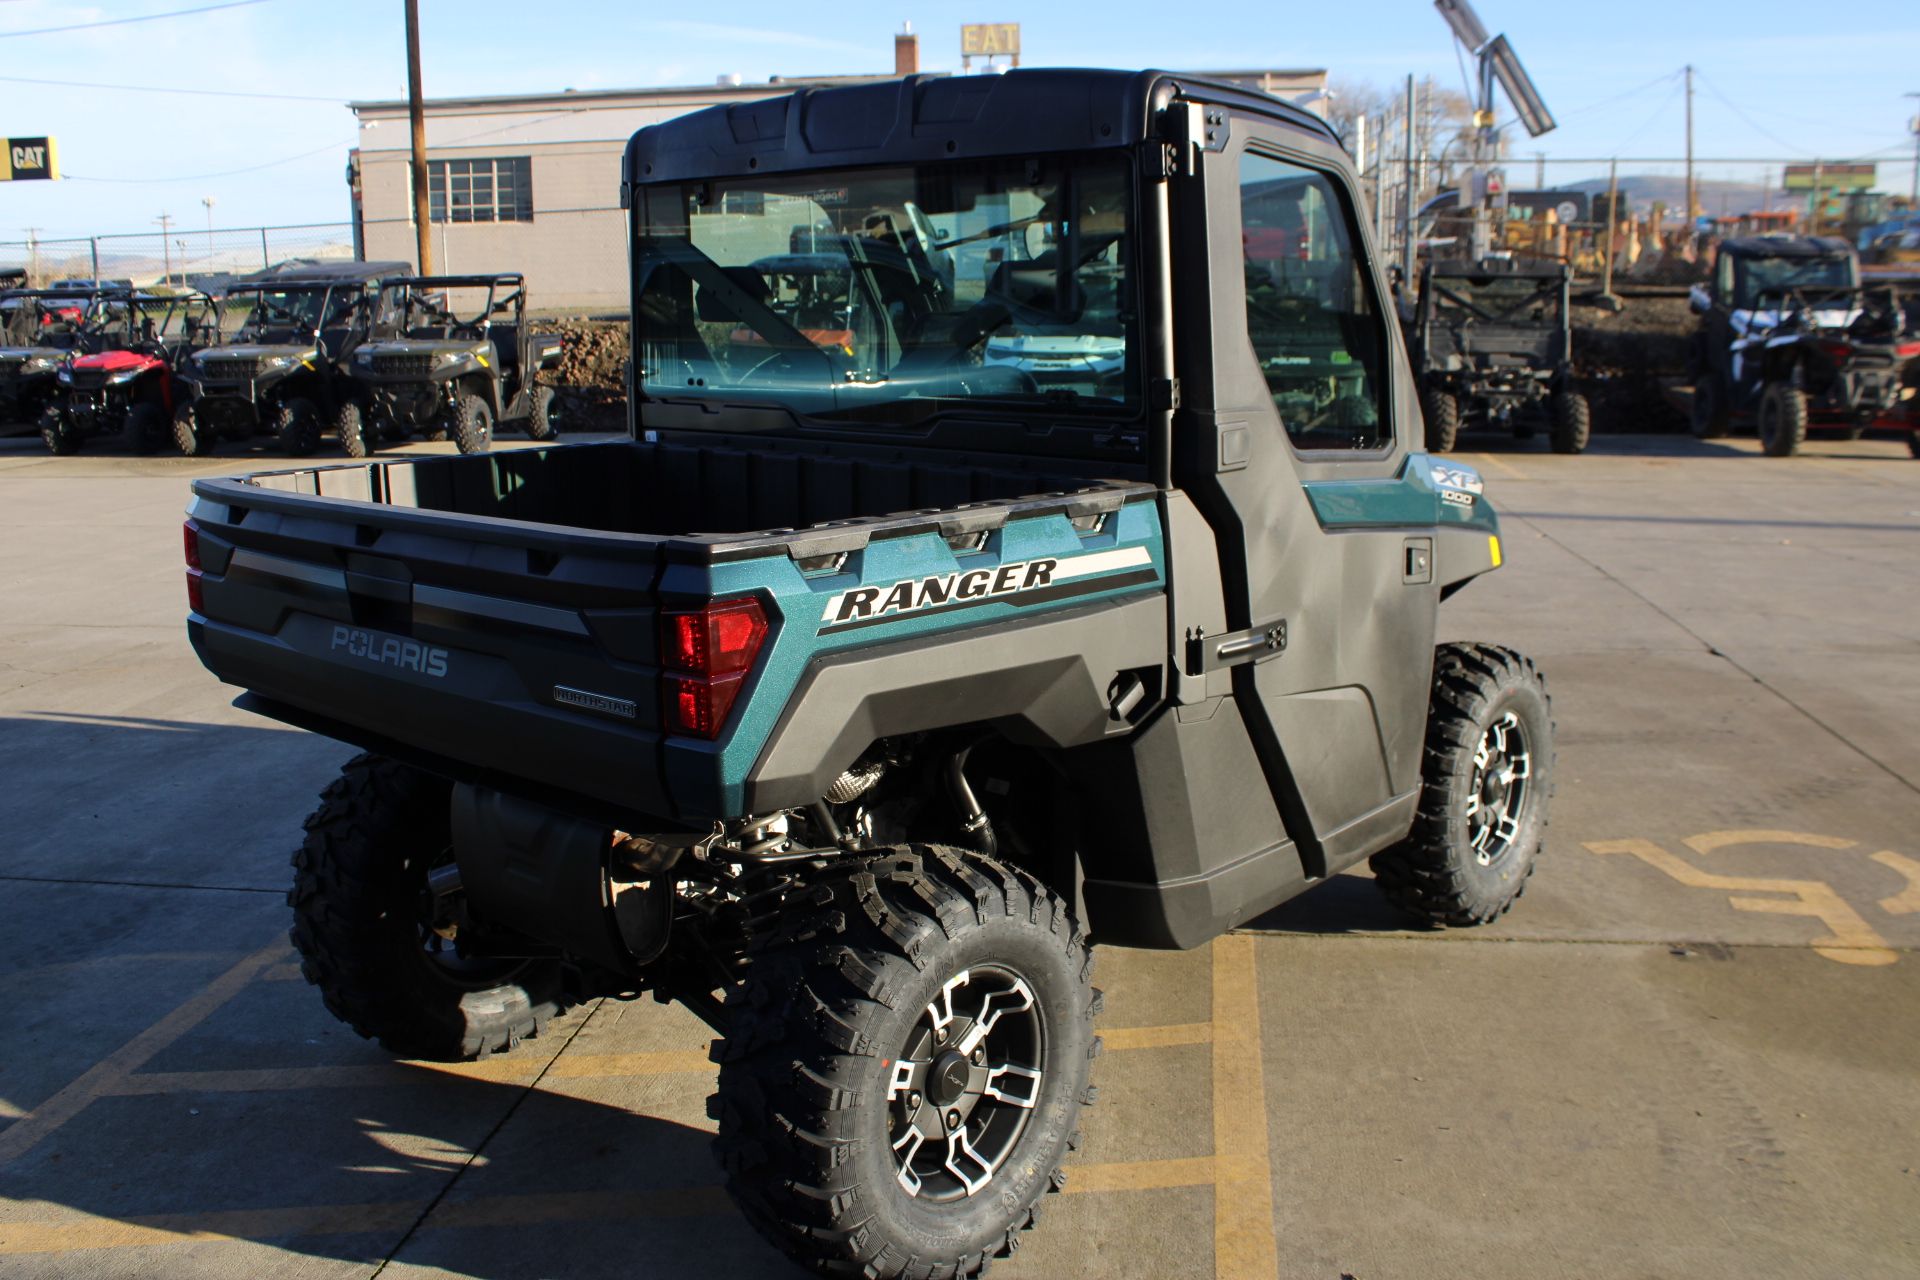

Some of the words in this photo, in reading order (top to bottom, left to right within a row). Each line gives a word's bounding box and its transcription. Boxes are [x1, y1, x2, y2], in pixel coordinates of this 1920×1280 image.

[963, 24, 1017, 53] EAT
[12, 146, 45, 170] CAT
[1436, 467, 1478, 489] XP
[1442, 490, 1473, 505] 1000
[834, 557, 1058, 622] RANGER
[331, 625, 449, 678] POLARIS
[558, 688, 634, 716] NORTHSTAR
